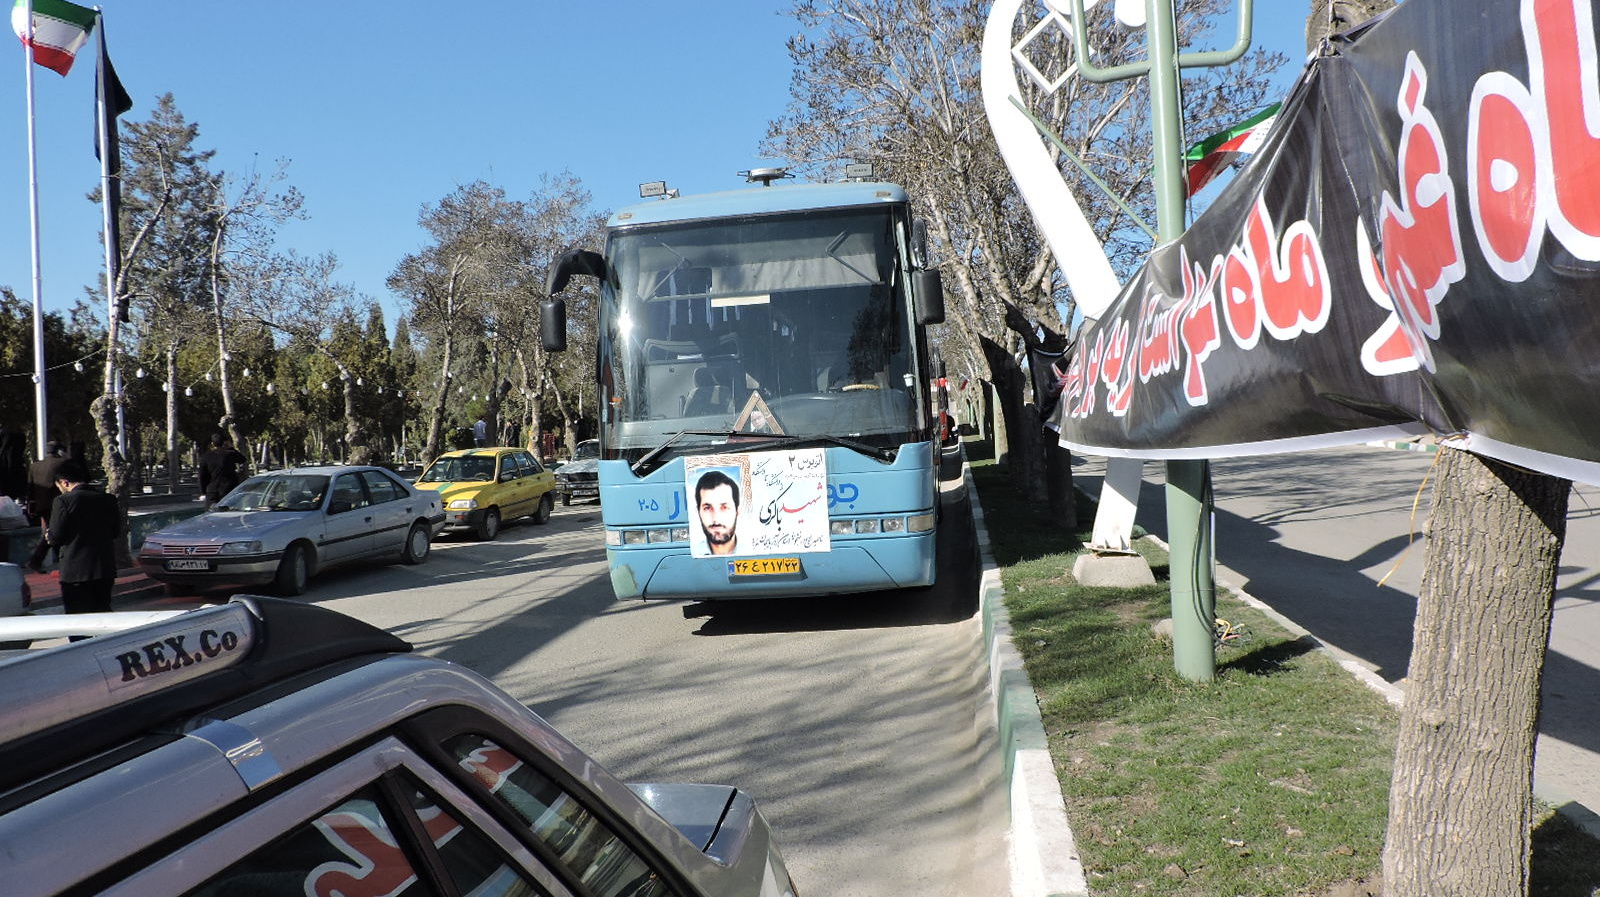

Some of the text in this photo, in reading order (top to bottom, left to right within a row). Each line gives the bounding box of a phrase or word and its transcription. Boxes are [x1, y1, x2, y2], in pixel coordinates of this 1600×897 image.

[1470, 0, 1600, 282] اه
[1220, 196, 1331, 351] ماه
[788, 454, 796, 471] ۲
[759, 481, 823, 531] شهید باکری
[115, 629, 238, 682] REX.Co
